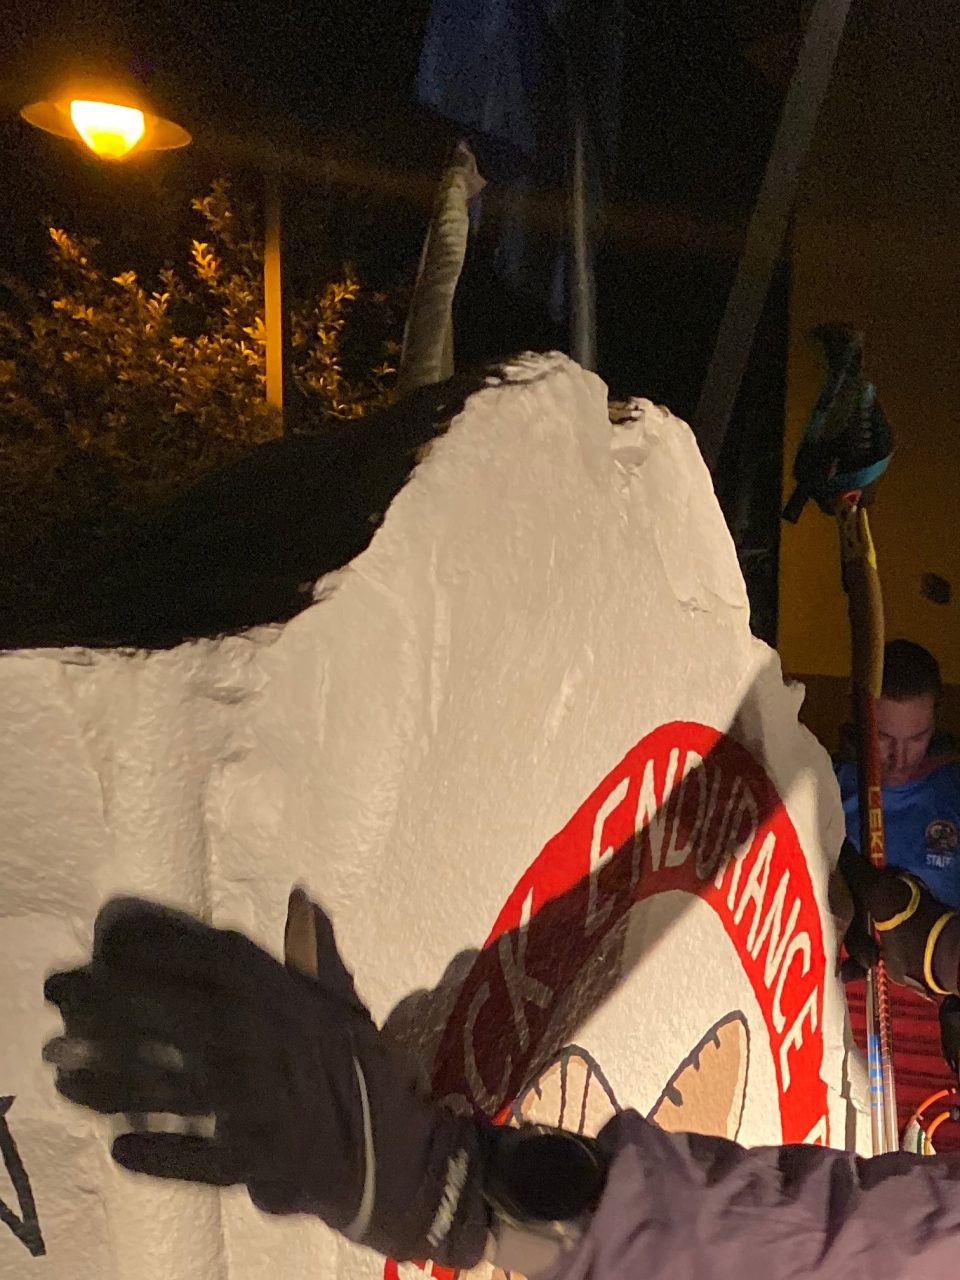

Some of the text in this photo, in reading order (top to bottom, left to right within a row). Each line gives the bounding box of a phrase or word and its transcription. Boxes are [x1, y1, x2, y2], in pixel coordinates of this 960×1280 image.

[867, 786, 885, 859] LEKI
[926, 853, 953, 868] STAFF
[583, 747, 818, 1093] ENDURANCE
